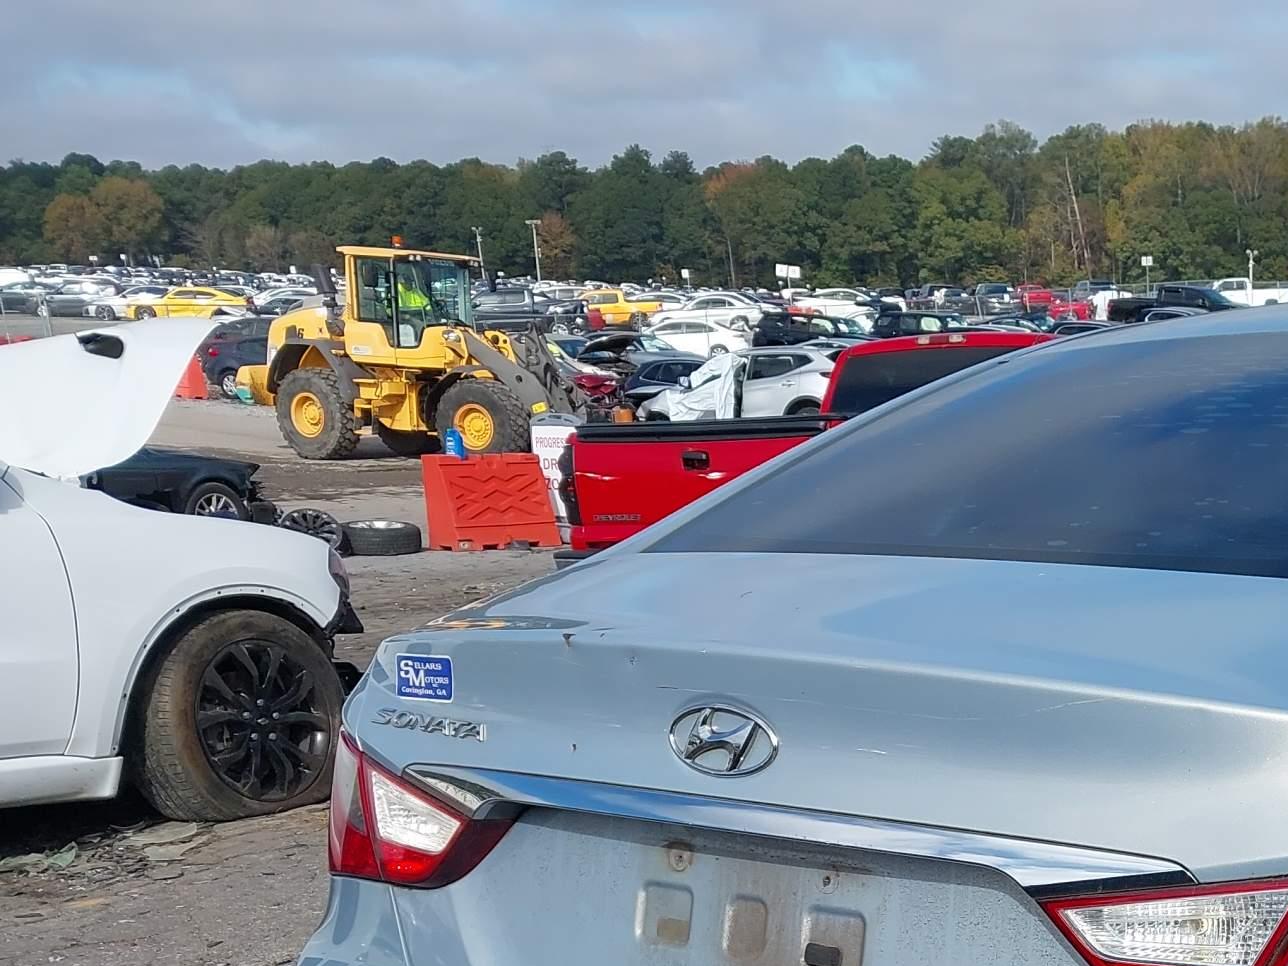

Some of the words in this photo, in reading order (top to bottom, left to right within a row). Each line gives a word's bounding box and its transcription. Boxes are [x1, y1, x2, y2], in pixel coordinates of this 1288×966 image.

[535, 436, 566, 449] PROGRES
[543, 458, 559, 470] DR
[544, 477, 560, 490] ZO
[409, 669, 449, 687] MOTORS
[436, 688, 447, 696] GA
[371, 708, 487, 742] SONATA
